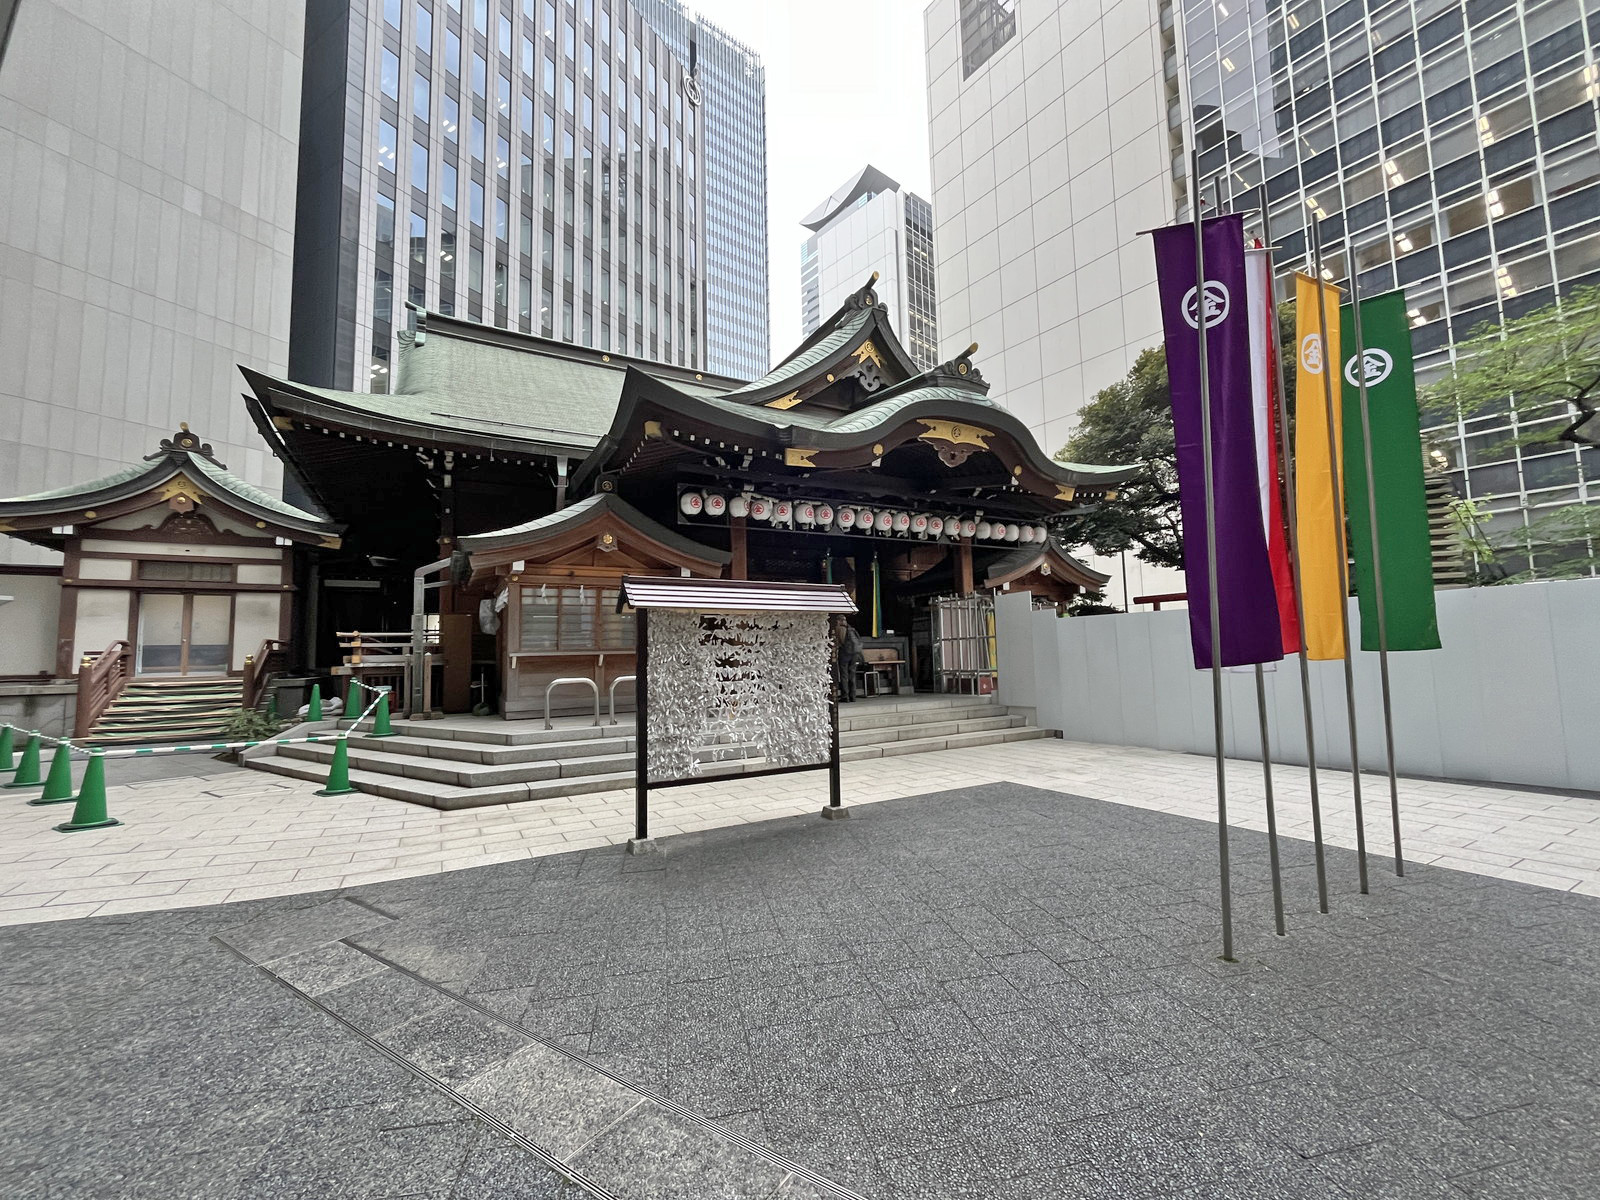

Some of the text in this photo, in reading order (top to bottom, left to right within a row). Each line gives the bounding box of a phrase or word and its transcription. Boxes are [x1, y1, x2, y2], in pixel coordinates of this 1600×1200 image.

[1186, 287, 1226, 322] 金
[1303, 338, 1320, 367] 金
[1350, 353, 1387, 380] 金
[713, 498, 722, 507] 金
[754, 504, 763, 513] 金
[778, 506, 787, 514] 金
